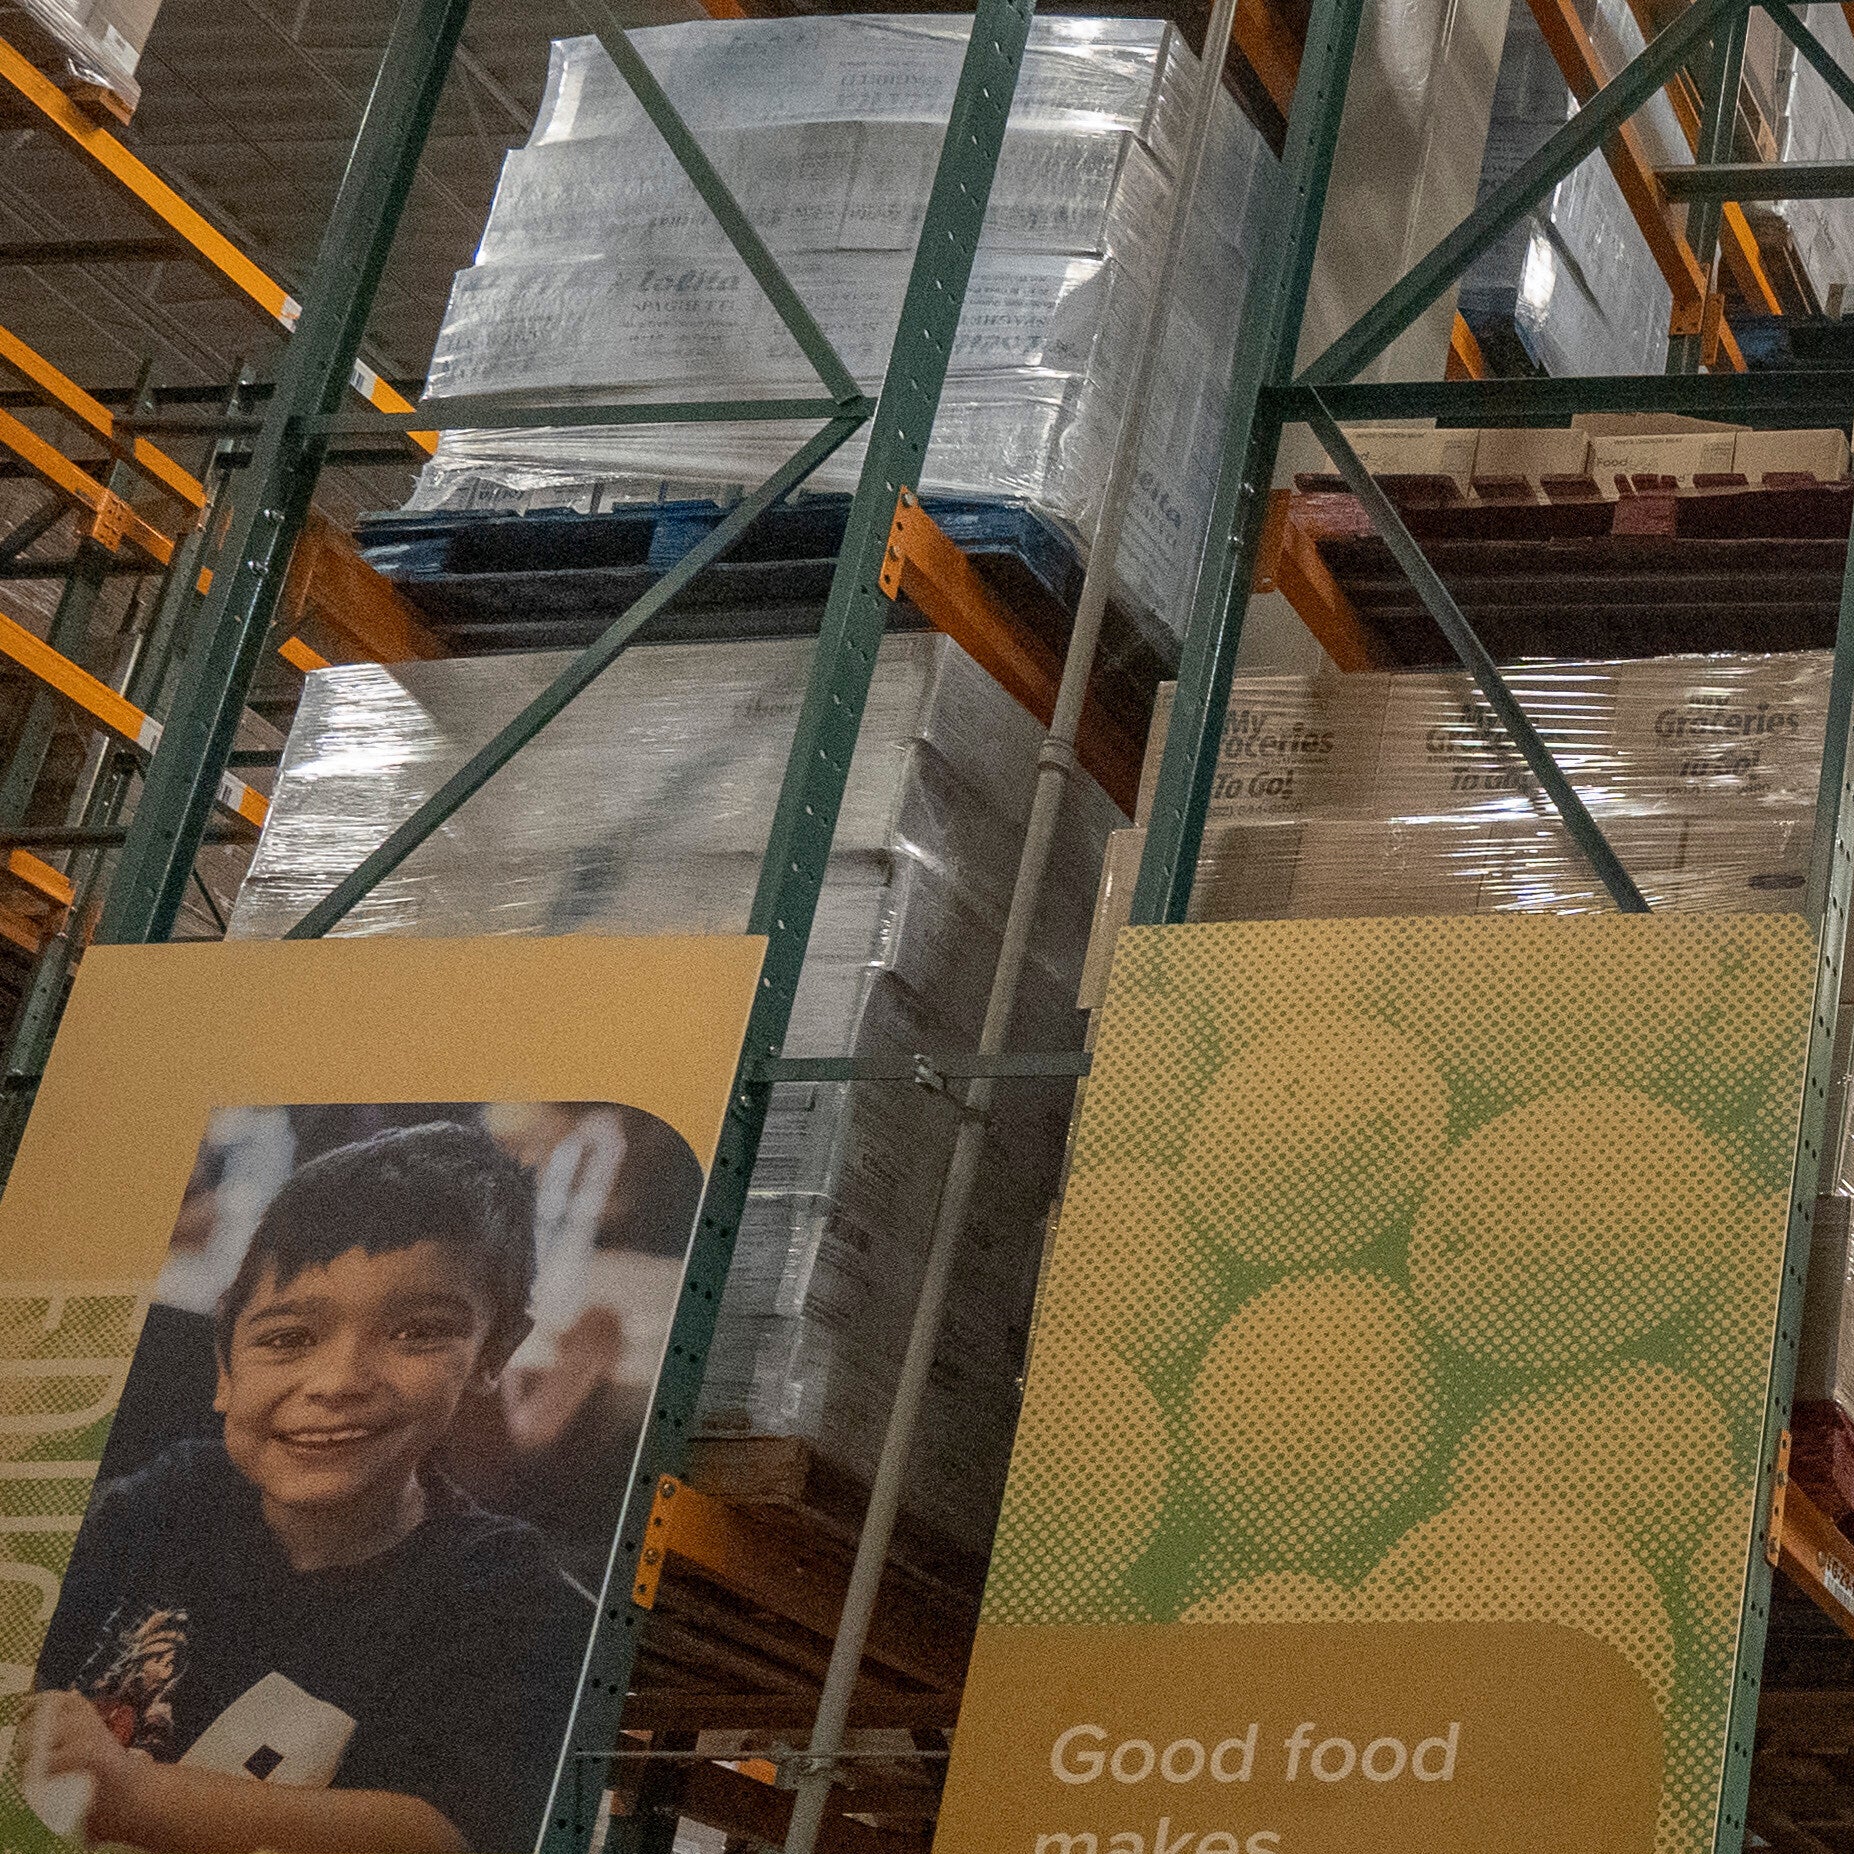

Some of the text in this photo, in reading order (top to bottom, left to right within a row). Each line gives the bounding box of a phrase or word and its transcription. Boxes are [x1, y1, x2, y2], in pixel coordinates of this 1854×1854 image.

[1219, 722, 1335, 759] oceries
[1214, 769, 1294, 800] To Go!
[1050, 1721, 1461, 1785] Good food
